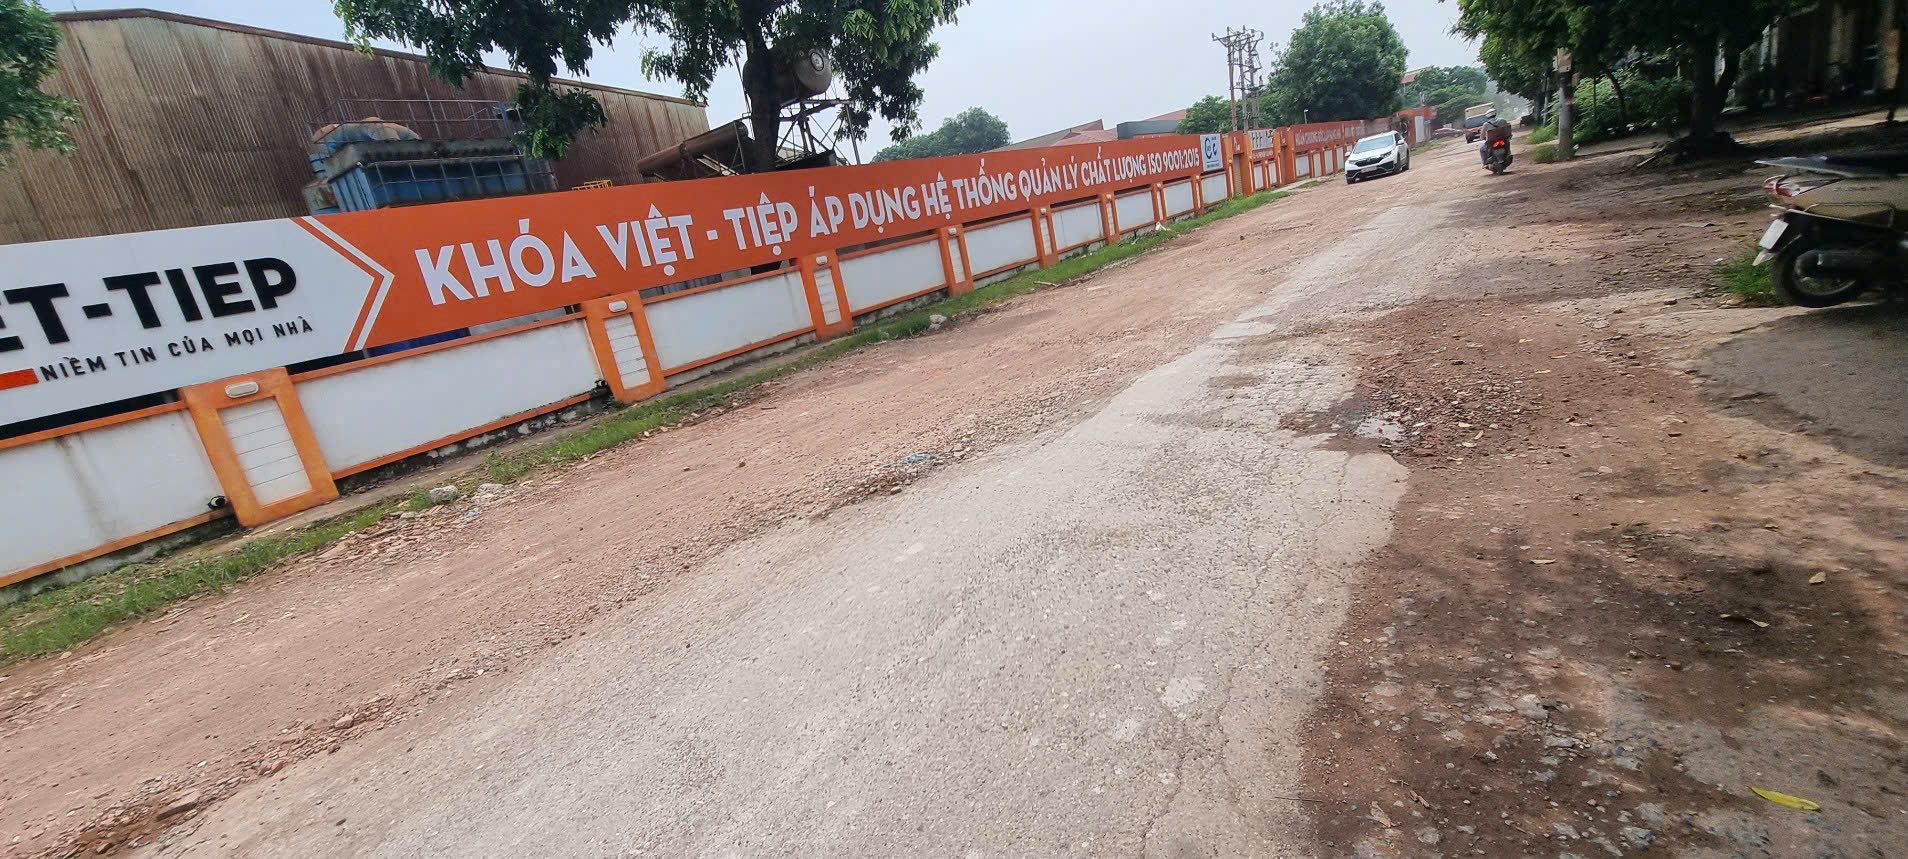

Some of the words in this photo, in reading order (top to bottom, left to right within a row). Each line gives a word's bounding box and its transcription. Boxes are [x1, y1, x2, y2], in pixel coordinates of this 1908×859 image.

[414, 217, 597, 306] KHÓA
[596, 203, 695, 277] VIỆT
[723, 191, 799, 256] TIỆP
[808, 185, 845, 238] ÁP
[847, 186, 922, 234] DỤNG
[921, 171, 952, 220] HỆ
[952, 158, 1018, 210] THỐNG
[1018, 157, 1062, 202] QUẢN
[1062, 155, 1078, 190] LÝ
[1081, 145, 1114, 186] CHẤT
[1113, 153, 1147, 183] LƯỢNG
[1147, 152, 1163, 175] ISO
[1162, 147, 1200, 173] 9001:2015
[40, 355, 107, 381] NIỀM
[114, 345, 157, 367] TIN
[167, 334, 214, 357] CỦA
[224, 327, 265, 346] MỌI
[272, 315, 314, 339] NHÀ
